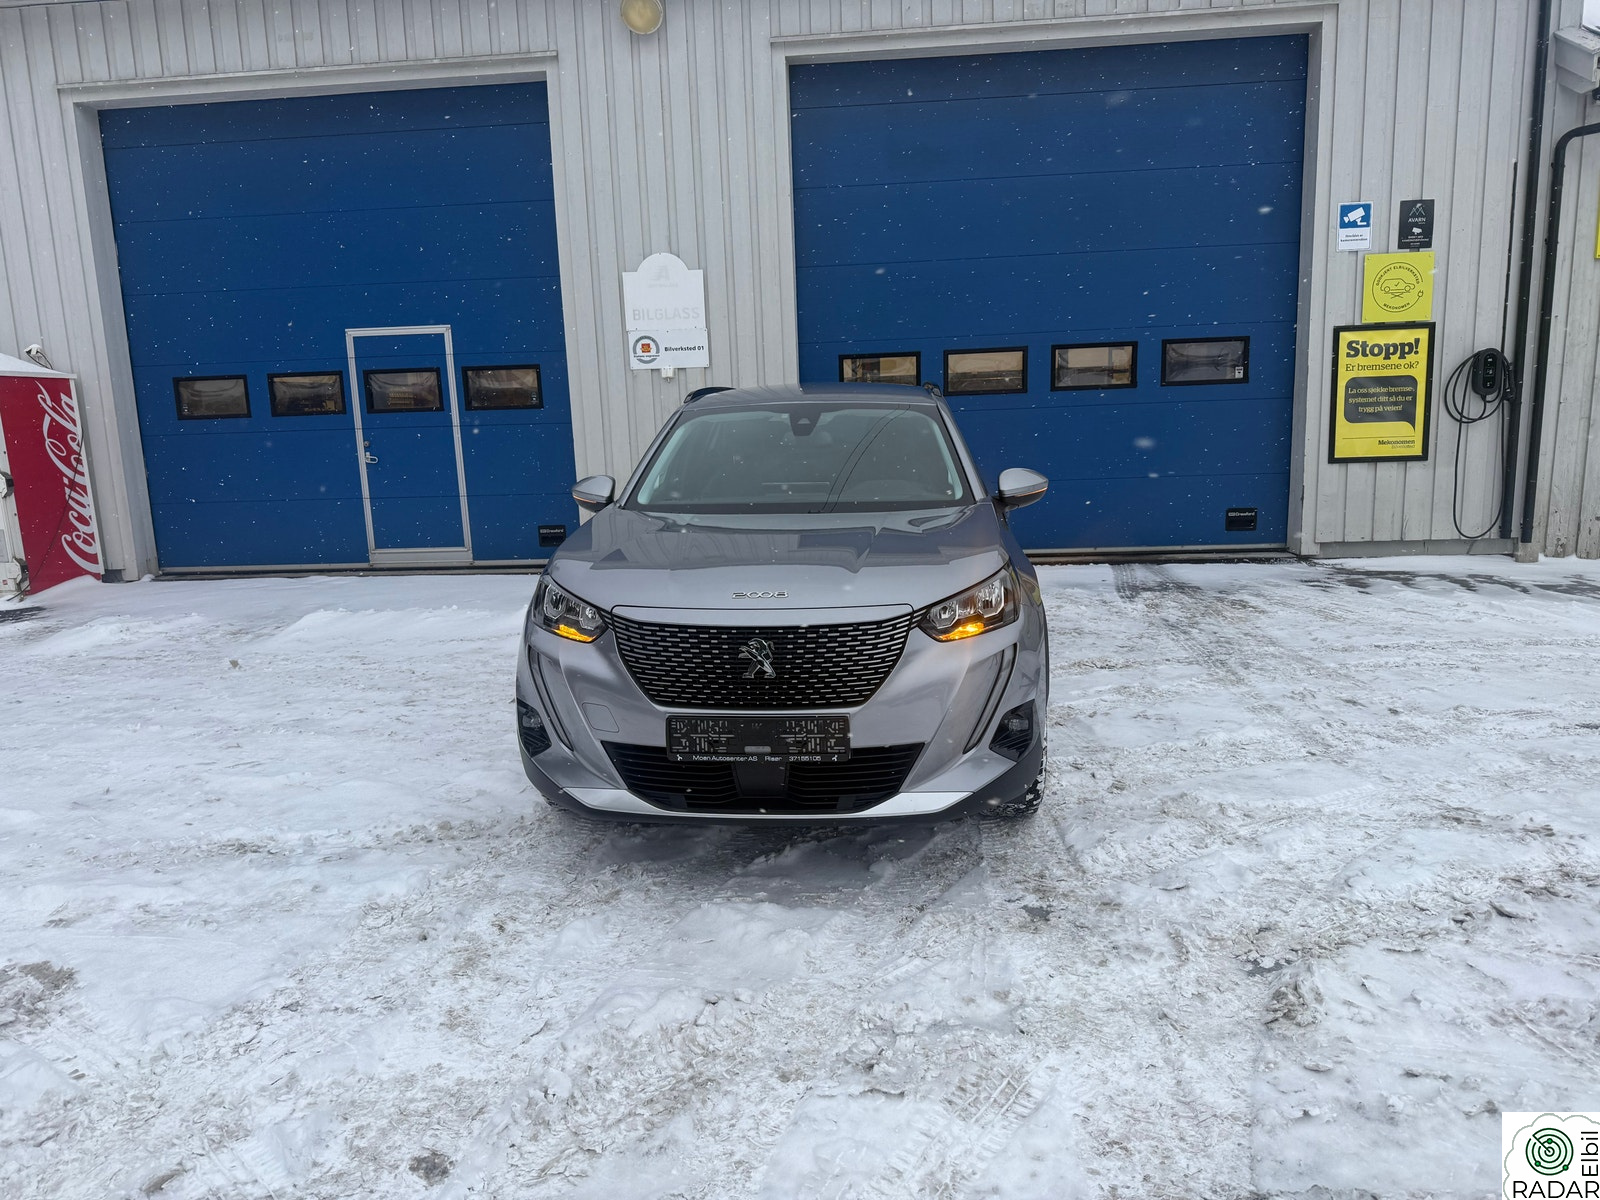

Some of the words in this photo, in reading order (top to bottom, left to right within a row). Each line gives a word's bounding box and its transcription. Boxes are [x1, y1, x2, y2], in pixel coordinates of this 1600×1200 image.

[1376, 266, 1392, 286] GODKJENT
[1393, 265, 1420, 285] ELBILVERKSTED
[1383, 302, 1410, 310] MEKONOMEN
[632, 307, 700, 321] BILGLASS
[1345, 337, 1420, 360] Stopp!
[1345, 363, 1356, 372] Er
[1357, 362, 1402, 371] bremsene
[1403, 361, 1419, 370] ok?
[1368, 386, 1388, 394] sjekke
[1348, 396, 1377, 404] systemet
[732, 591, 789, 600] 2008
